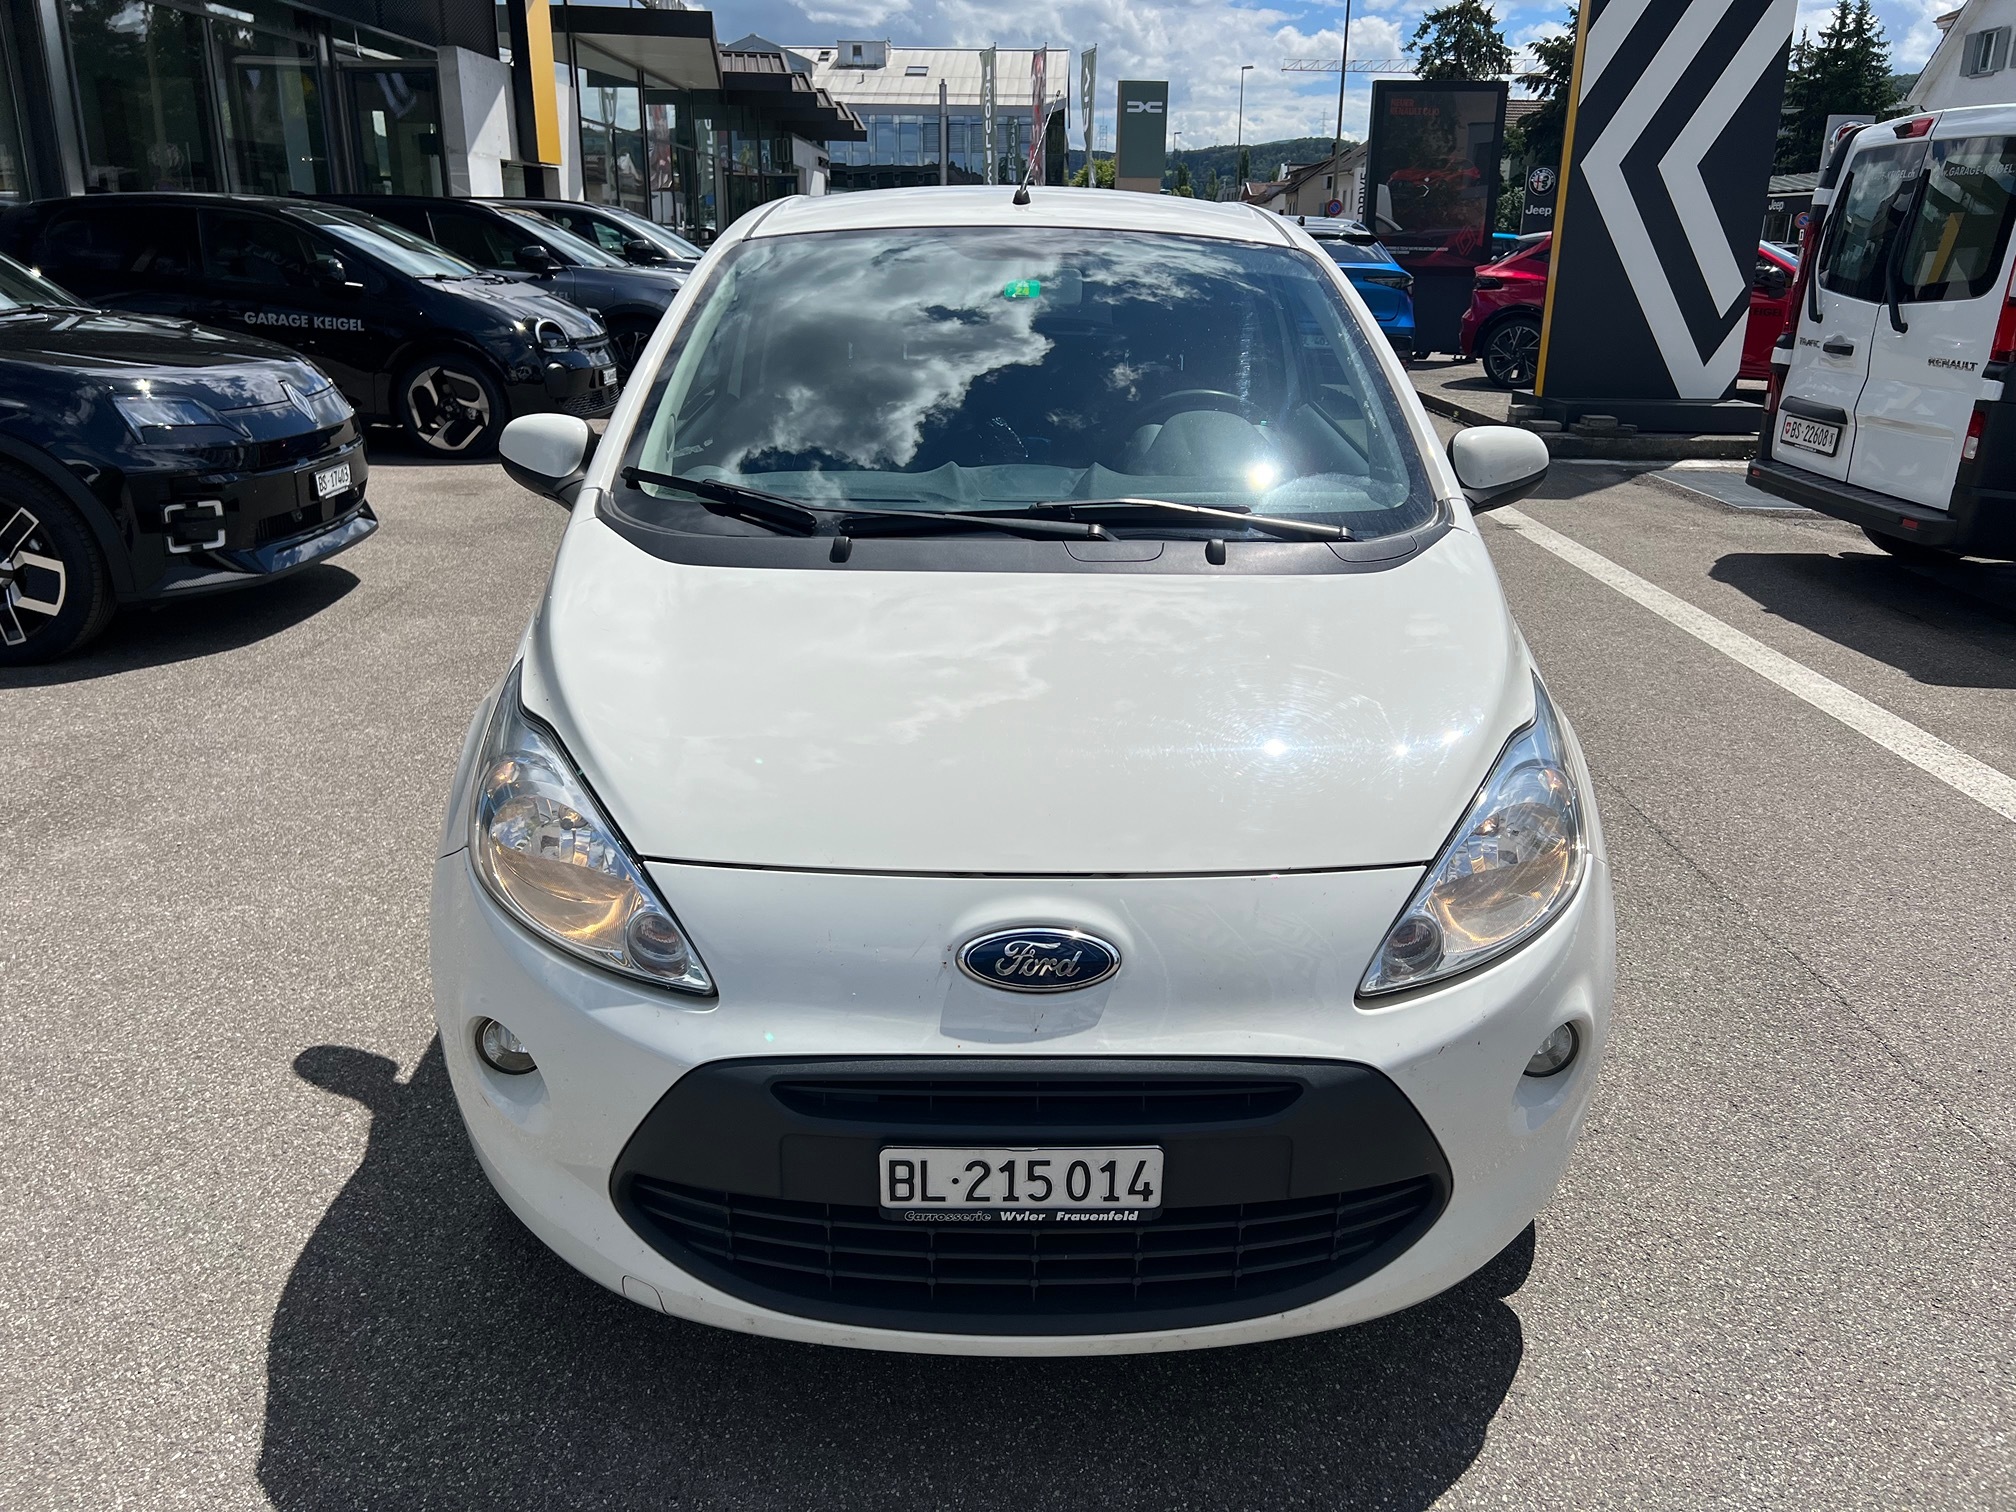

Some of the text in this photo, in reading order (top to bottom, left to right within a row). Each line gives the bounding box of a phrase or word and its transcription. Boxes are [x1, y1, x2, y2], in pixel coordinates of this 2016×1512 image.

[1525, 205, 1552, 217] Jeep
[1768, 199, 1785, 212] Jeep
[244, 311, 365, 332] GARAGE KEIGEL
[1927, 357, 1979, 372] RENAULT
[995, 940, 1083, 977] Ford
[904, 1210, 1139, 1222] Carrosserie Wyler Frauenfeld
